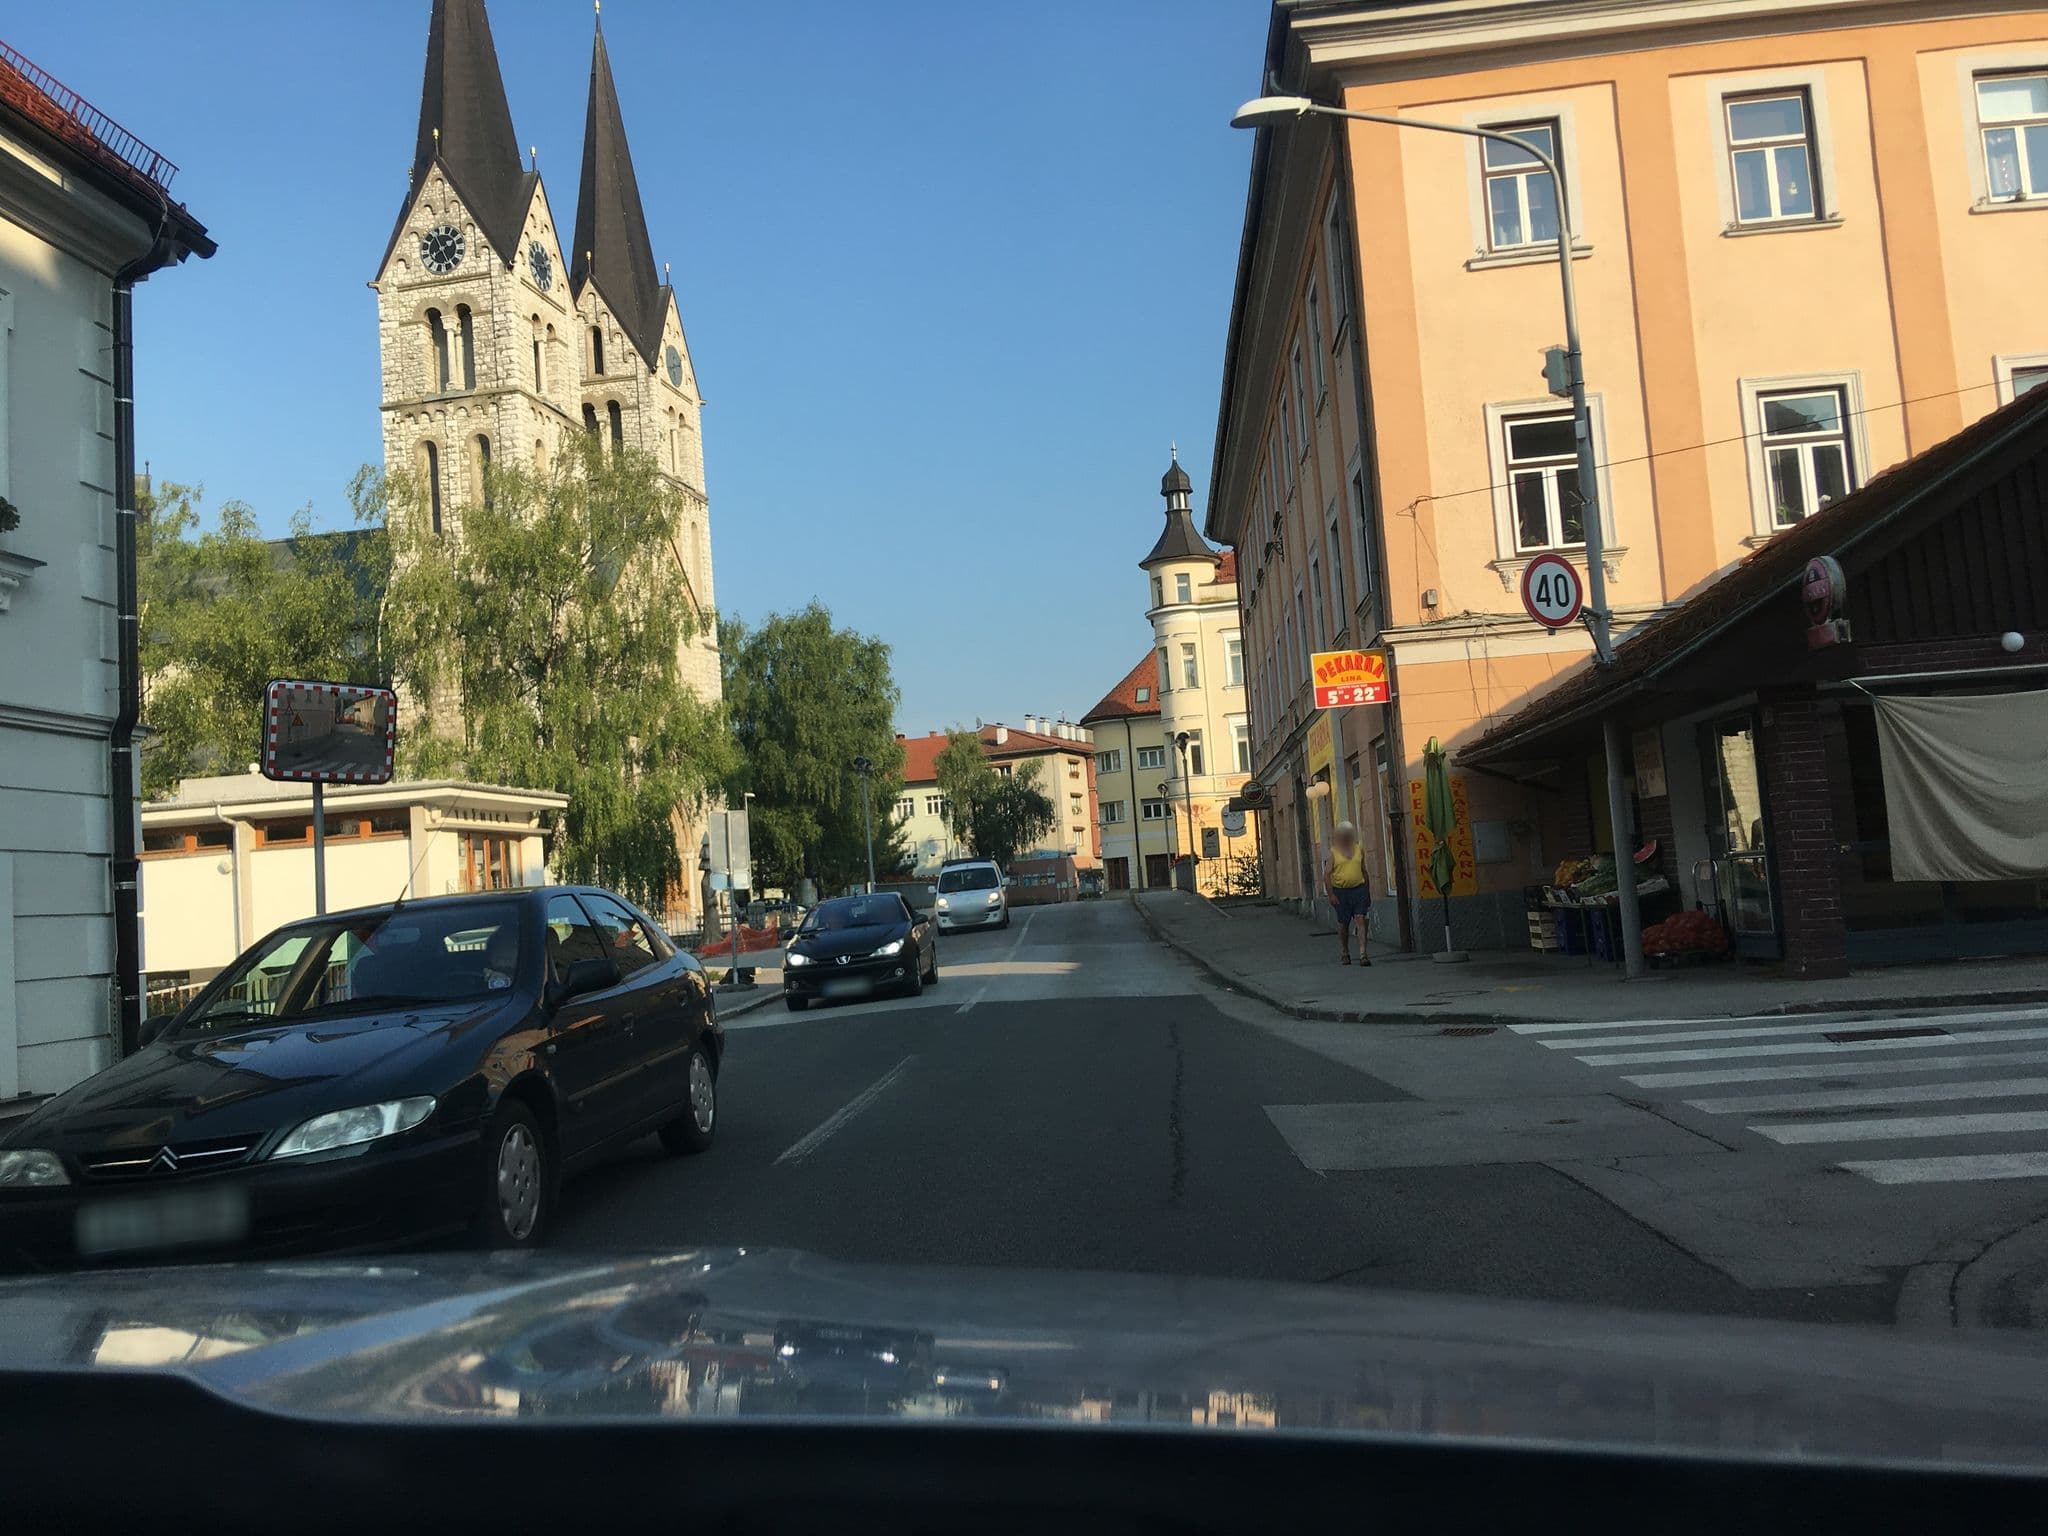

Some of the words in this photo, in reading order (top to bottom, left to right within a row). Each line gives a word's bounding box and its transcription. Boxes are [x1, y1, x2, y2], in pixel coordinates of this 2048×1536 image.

[1536, 573, 1570, 608] 40
[1316, 654, 1385, 683] PEKARNA
[1411, 782, 1434, 891] PEKARNA
